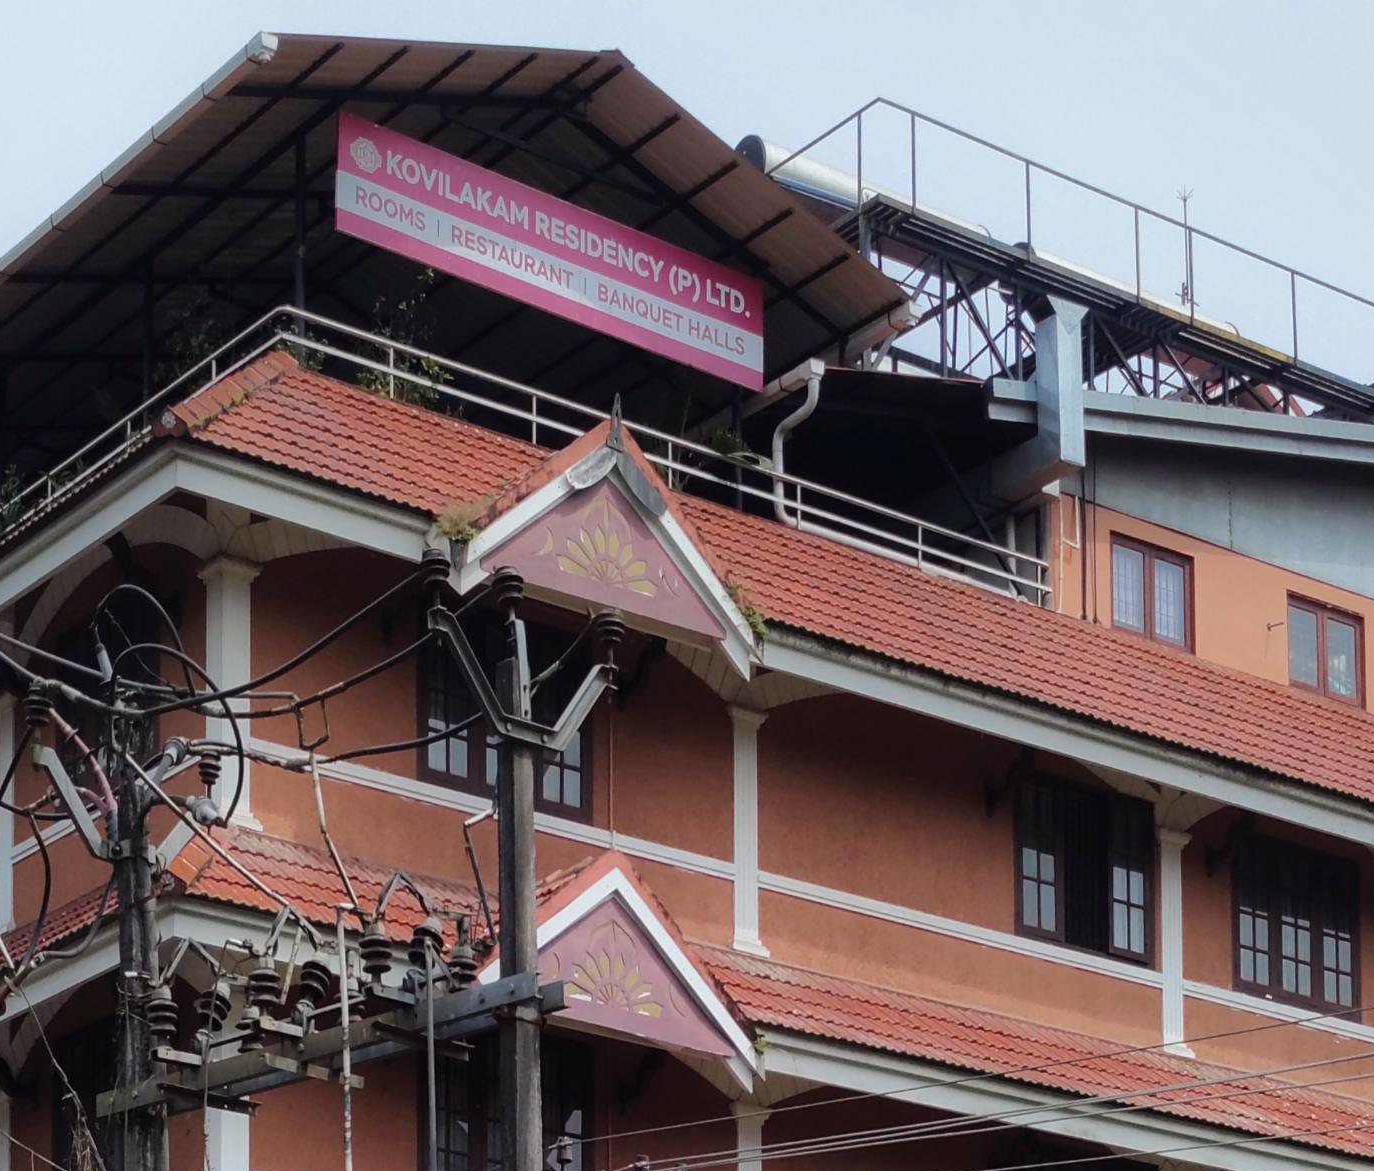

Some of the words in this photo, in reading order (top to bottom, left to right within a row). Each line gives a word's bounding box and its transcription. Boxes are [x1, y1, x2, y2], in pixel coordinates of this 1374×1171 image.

[354, 185, 427, 232] ROOMS
[450, 223, 575, 290] RESTAURANT
[597, 282, 684, 332] BANQUET
[688, 319, 746, 356] HALLS
[386, 150, 529, 231] KOVILAKAM
[534, 210, 665, 283] RESIDENCY
[669, 263, 701, 304] (P)
[706, 278, 753, 319] LTD.
